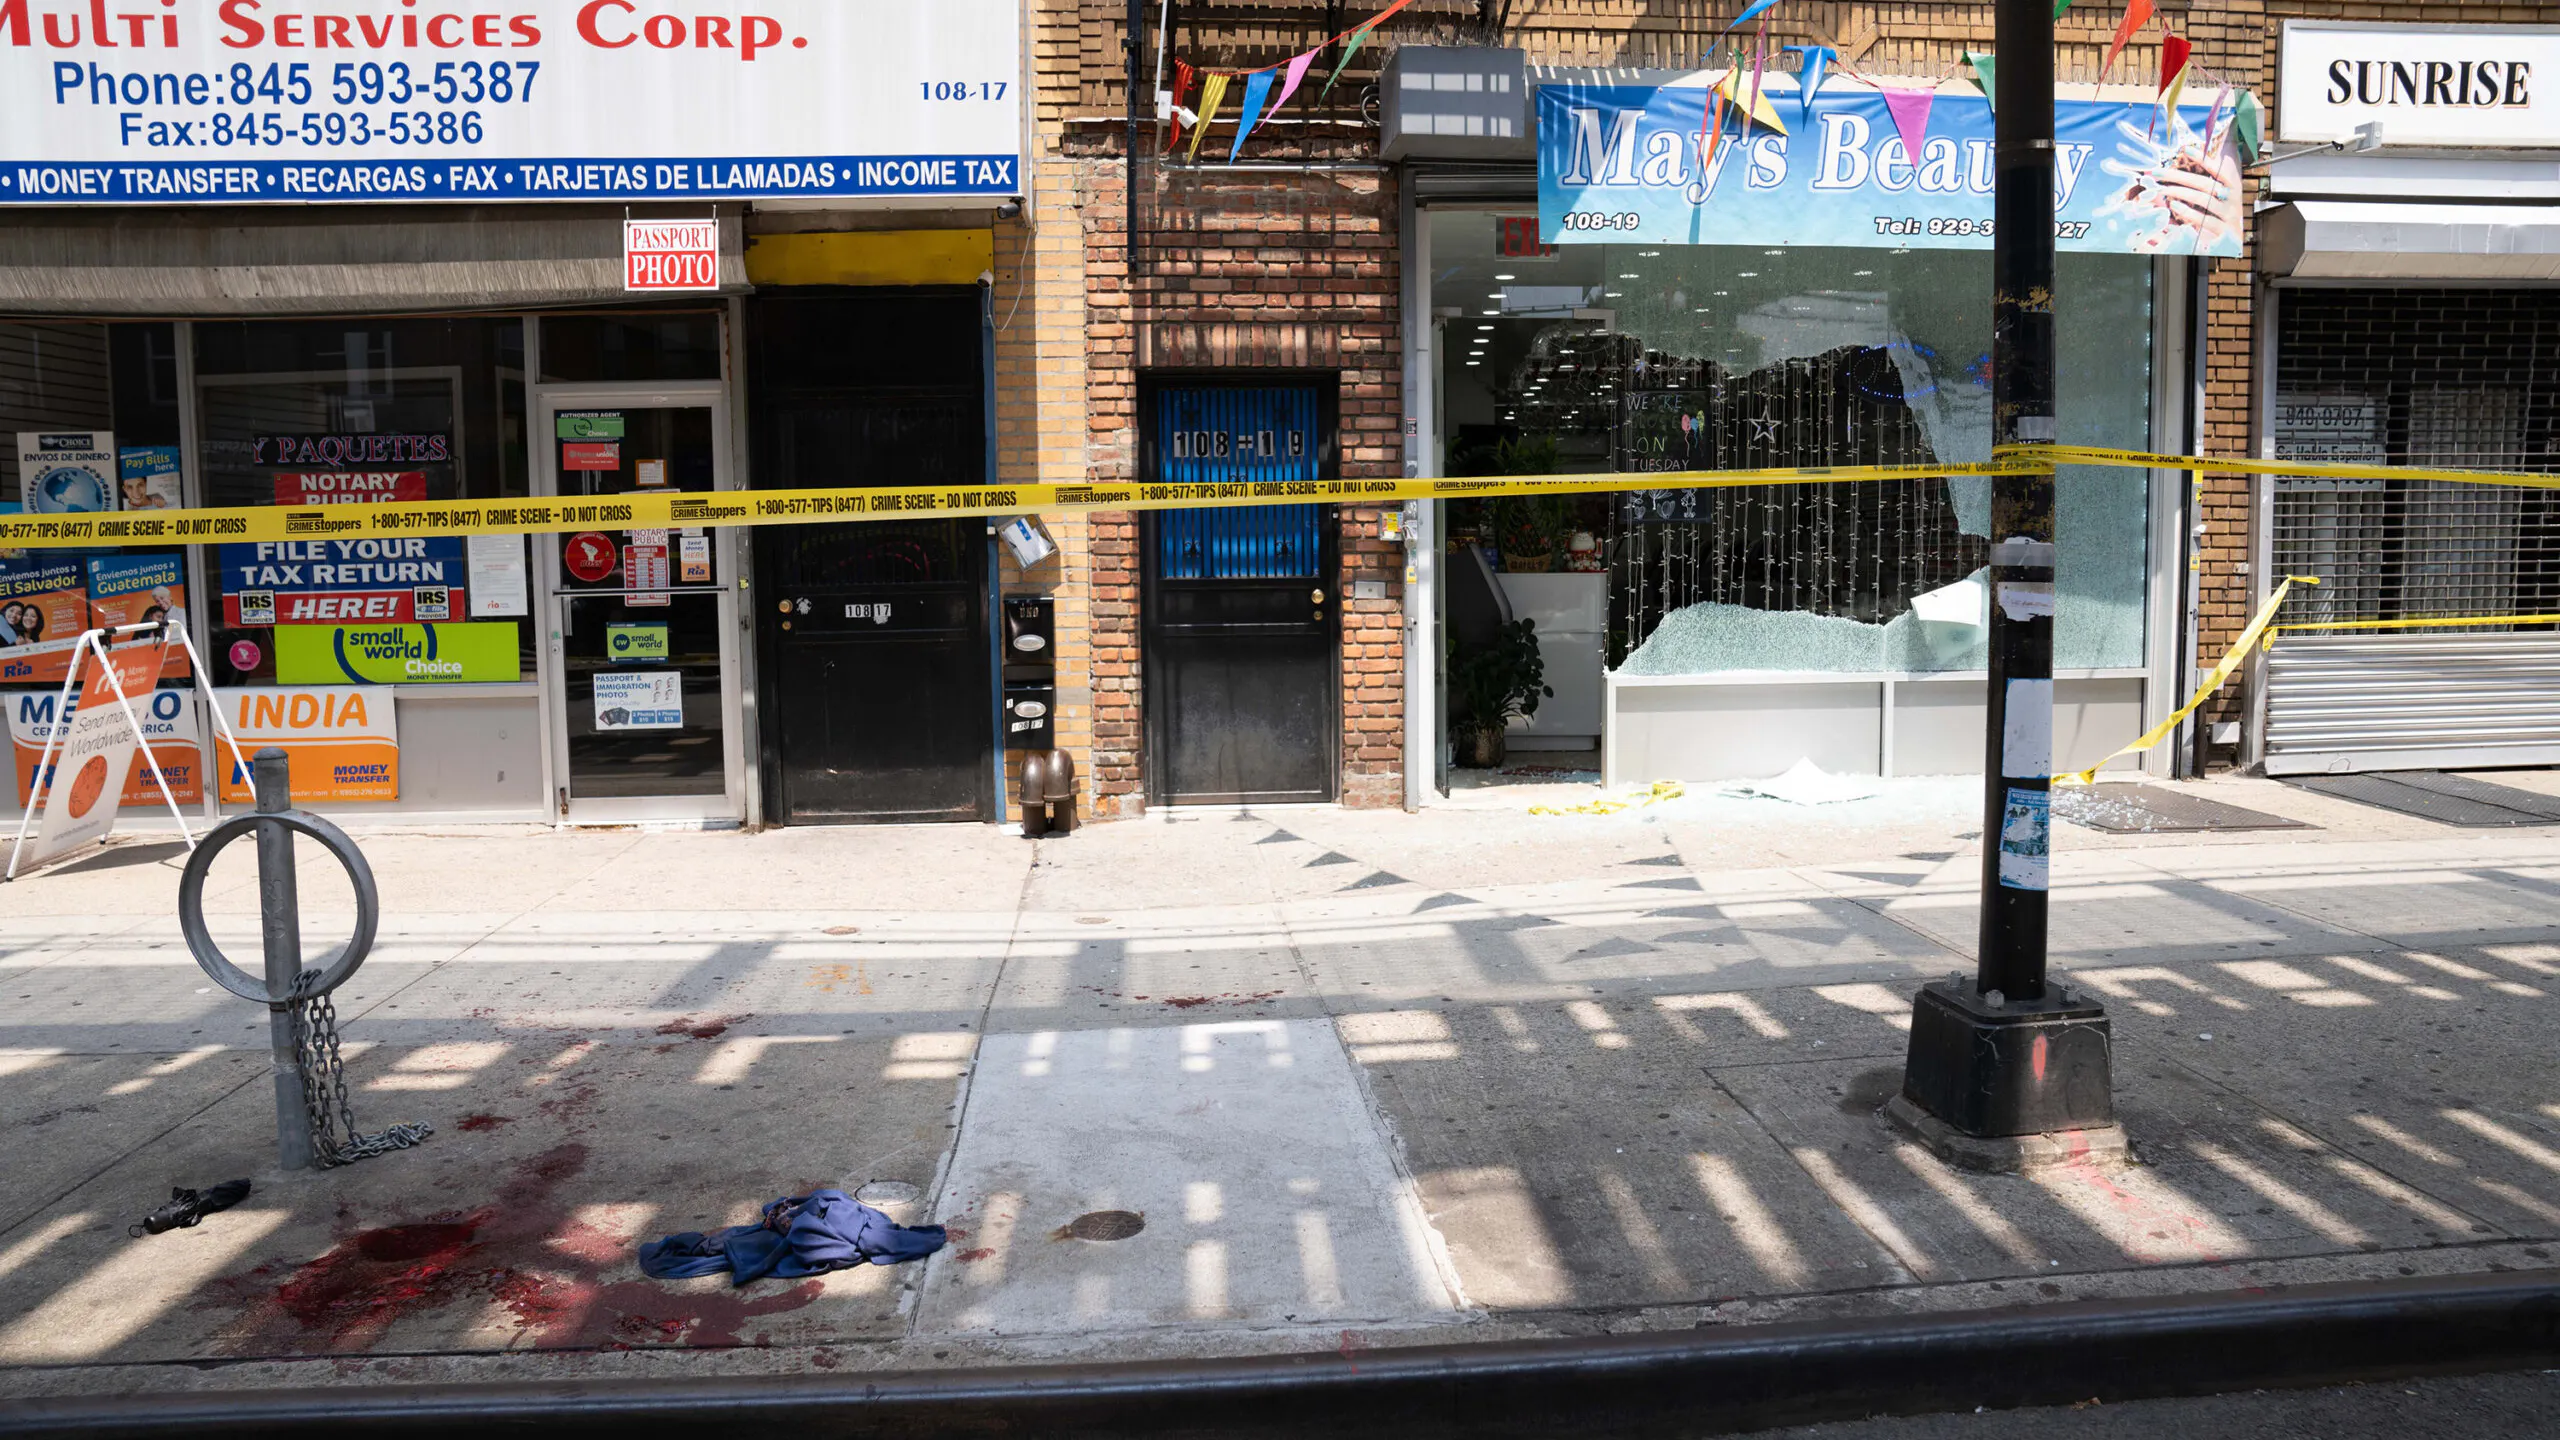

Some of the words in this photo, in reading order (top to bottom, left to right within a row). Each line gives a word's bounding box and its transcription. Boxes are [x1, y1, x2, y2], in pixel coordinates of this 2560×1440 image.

[332, 61, 541, 104] 593-5387
[920, 81, 1008, 101] 108-17
[2327, 59, 2531, 108] SUNRISE
[120, 111, 484, 147] Fax:845-593-5386
[1562, 108, 1789, 205] May's
[1814, 112, 2093, 212] Beauy
[18, 168, 112, 195] MONEY
[119, 167, 259, 194] TRANSFER
[283, 166, 425, 192] RECARGAS
[449, 165, 497, 191] FAX
[519, 165, 647, 190] TARJETAS
[656, 165, 688, 190] DE
[697, 163, 835, 189] LLAMADAS
[858, 161, 956, 187] INCOME
[963, 160, 1012, 185] TAX
[1563, 212, 1640, 231] 108-19
[1875, 217, 1921, 236] Tel:
[633, 227, 711, 249] PASSPORT
[632, 254, 713, 284] PHOTO
[59, 437, 91, 448] CHOICE
[253, 437, 268, 463] Y
[277, 435, 448, 466] PAQUETES
[1637, 436, 1665, 453] ON
[24, 452, 59, 461] ENVIOS
[61, 452, 72, 461] DE
[76, 452, 110, 461] DINERO
[126, 457, 144, 469] Pay
[146, 454, 170, 465] Bills
[2296, 446, 2328, 460] Habla
[155, 463, 174, 472] here
[1630, 458, 1690, 472] TUESDAY
[300, 473, 400, 491] NOTARY
[1140, 485, 1216, 501] 1-800-577-TIPS
[1218, 483, 1248, 499] (8477)
[1254, 482, 1284, 497] CRIME
[1287, 482, 1317, 495] SCENE
[756, 497, 832, 515] 1-800-577-TIPS
[835, 495, 865, 513] (8477)
[871, 494, 902, 511] CRIME
[905, 493, 935, 510] SCENE
[947, 492, 960, 508] DO
[963, 491, 982, 507] NOT
[984, 490, 1016, 506] CROSS
[371, 511, 448, 528] 1-800-577-TIPS
[450, 509, 481, 528] (8477)
[486, 509, 517, 525] CRIME
[520, 508, 551, 524] SCENE
[563, 507, 576, 522] DO
[579, 506, 598, 522] NOT
[600, 505, 632, 521] CROSS
[61, 521, 93, 539] (8477)
[98, 522, 130, 537] CRIME
[132, 521, 164, 536] SCENE
[177, 520, 189, 536] DO
[192, 519, 214, 535] NOT
[217, 518, 247, 534] CROSS
[634, 529, 668, 537] NOTARY
[257, 540, 326, 561] FILE
[333, 538, 426, 560] YOUR
[634, 536, 667, 544] PUBLIC
[0, 572, 39, 581] nviemos
[41, 566, 70, 578] juntos
[96, 567, 139, 581] Enviemos
[139, 563, 166, 576] juntos
[168, 561, 175, 569] a
[241, 566, 304, 585] TAX
[313, 562, 443, 584] RETURN
[687, 565, 705, 576] Ria
[15, 575, 77, 591] Salvador
[97, 571, 176, 594] Guatemala
[242, 595, 272, 608] IRS
[417, 591, 446, 604] IRS
[291, 596, 399, 620] HERE!
[846, 605, 870, 617] 108
[875, 604, 891, 616] 17
[349, 628, 403, 645] small
[631, 634, 654, 642] small
[638, 640, 662, 648] world
[364, 640, 422, 659] world
[4, 661, 32, 677] Ria
[405, 659, 463, 674] Choice
[239, 693, 368, 728] INDIA
[76, 714, 104, 734] Send
[71, 726, 133, 757] Worldwide
[334, 764, 388, 775] MONEY
[334, 775, 390, 784] TRANSFER
